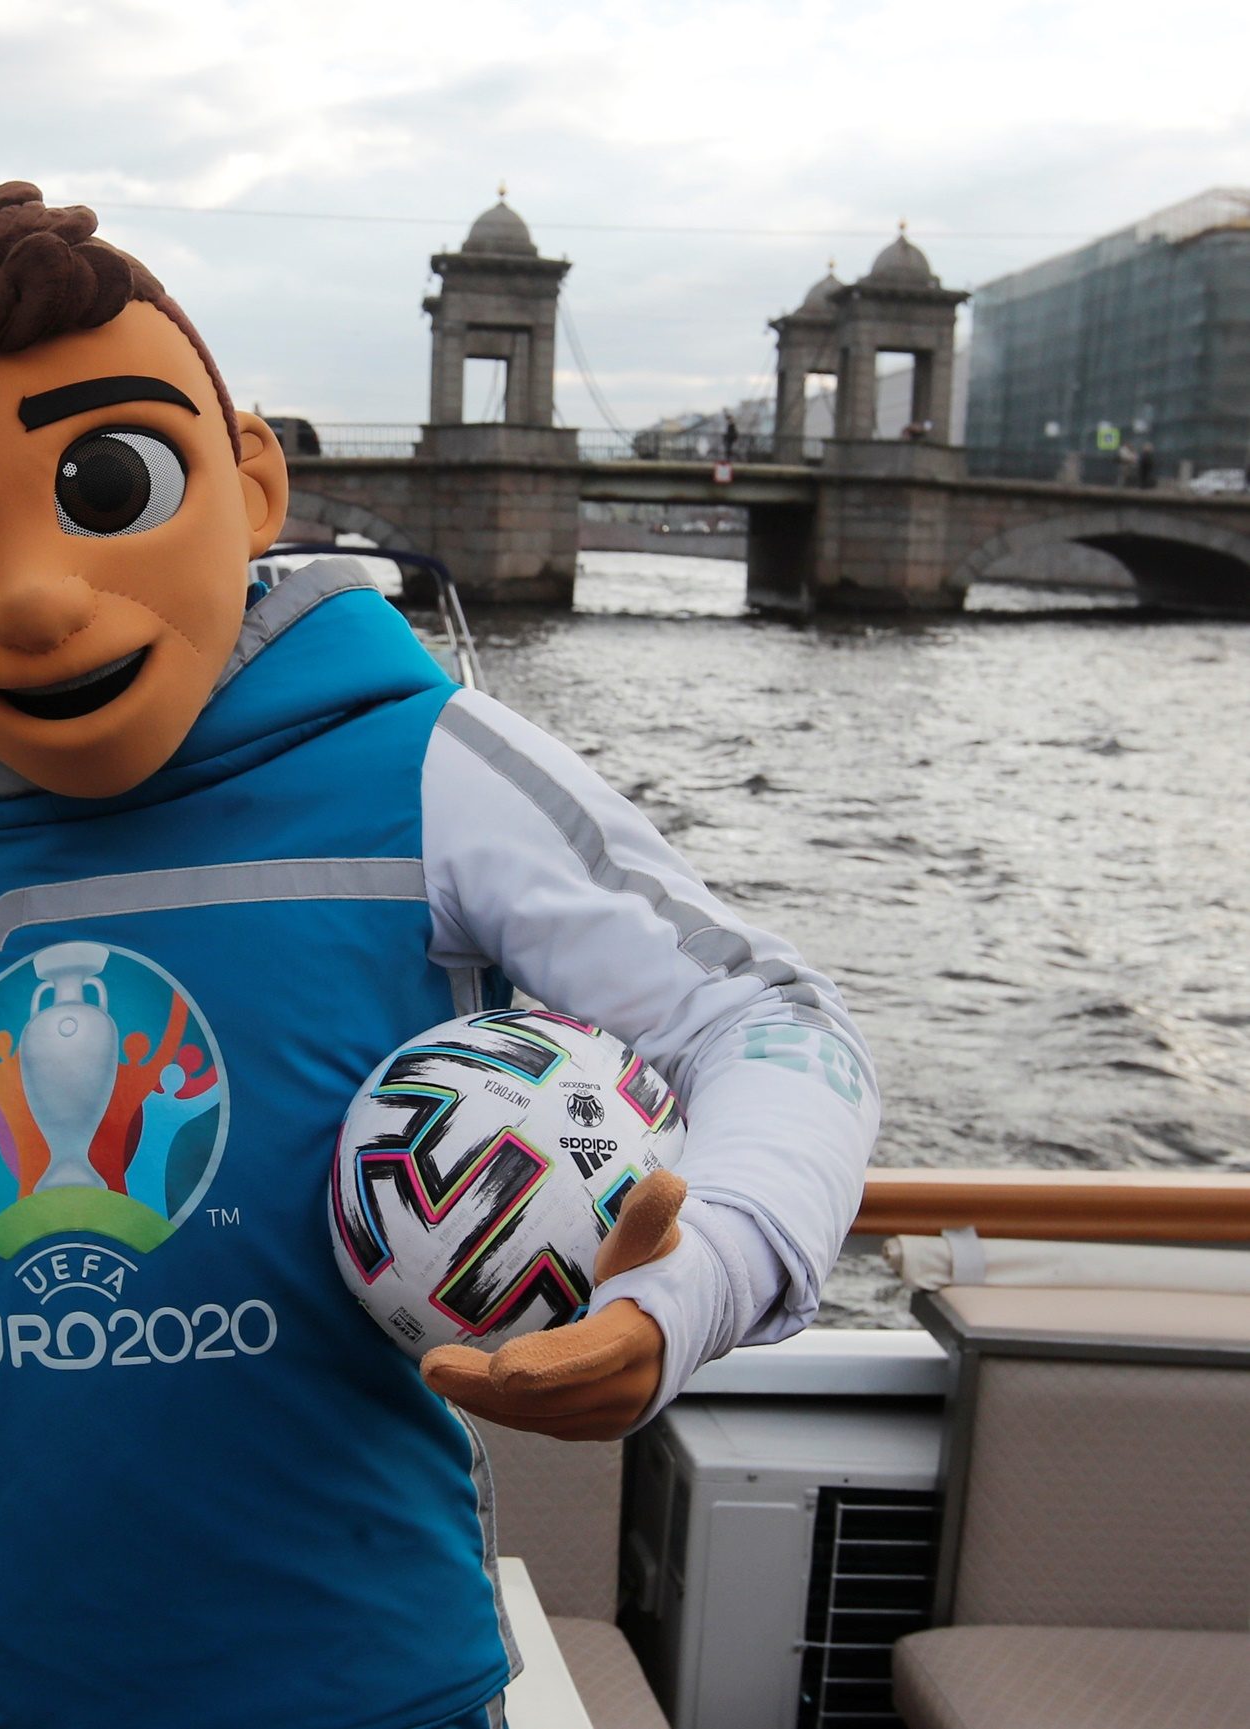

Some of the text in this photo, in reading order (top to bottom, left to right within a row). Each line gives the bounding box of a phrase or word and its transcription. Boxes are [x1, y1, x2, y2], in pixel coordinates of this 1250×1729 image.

[484, 1079, 530, 1108] UNIFORIA
[559, 1137, 618, 1153] adidas
[206, 1207, 241, 1227] TM
[22, 1253, 128, 1295] UEFA
